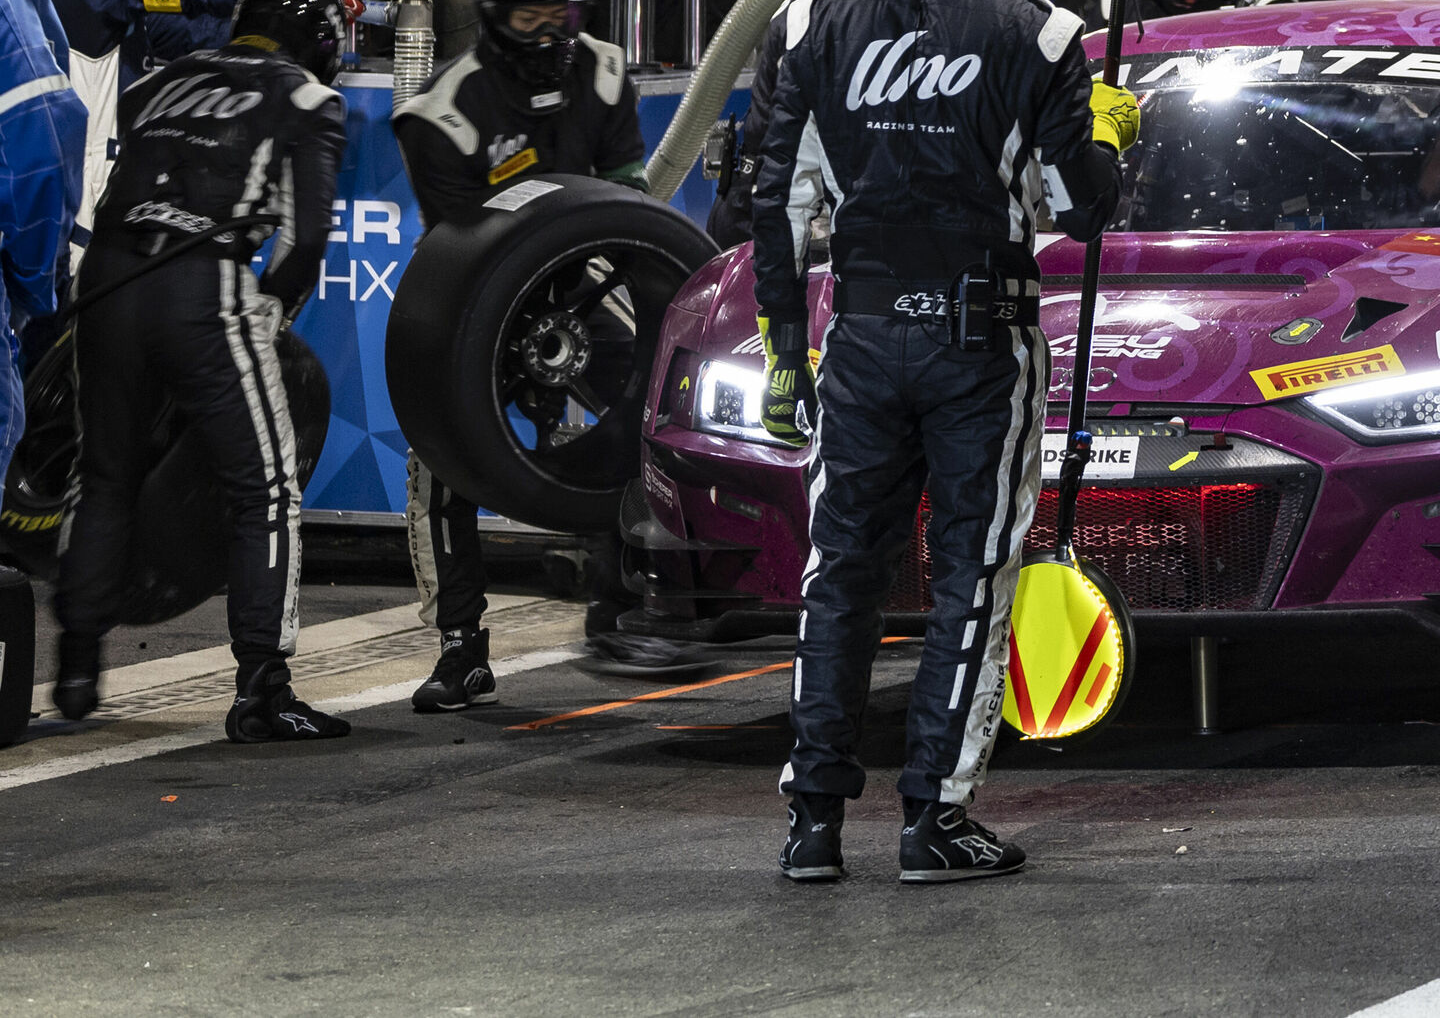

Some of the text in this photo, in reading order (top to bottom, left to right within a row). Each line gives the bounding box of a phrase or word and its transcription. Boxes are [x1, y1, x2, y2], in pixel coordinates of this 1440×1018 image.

[846, 30, 982, 112] Uno
[866, 121, 956, 134] RACING TEAM
[1267, 353, 1390, 392] PIRELLI
[1041, 449, 1132, 464] DSRIKE
[982, 663, 1007, 739] RACING
